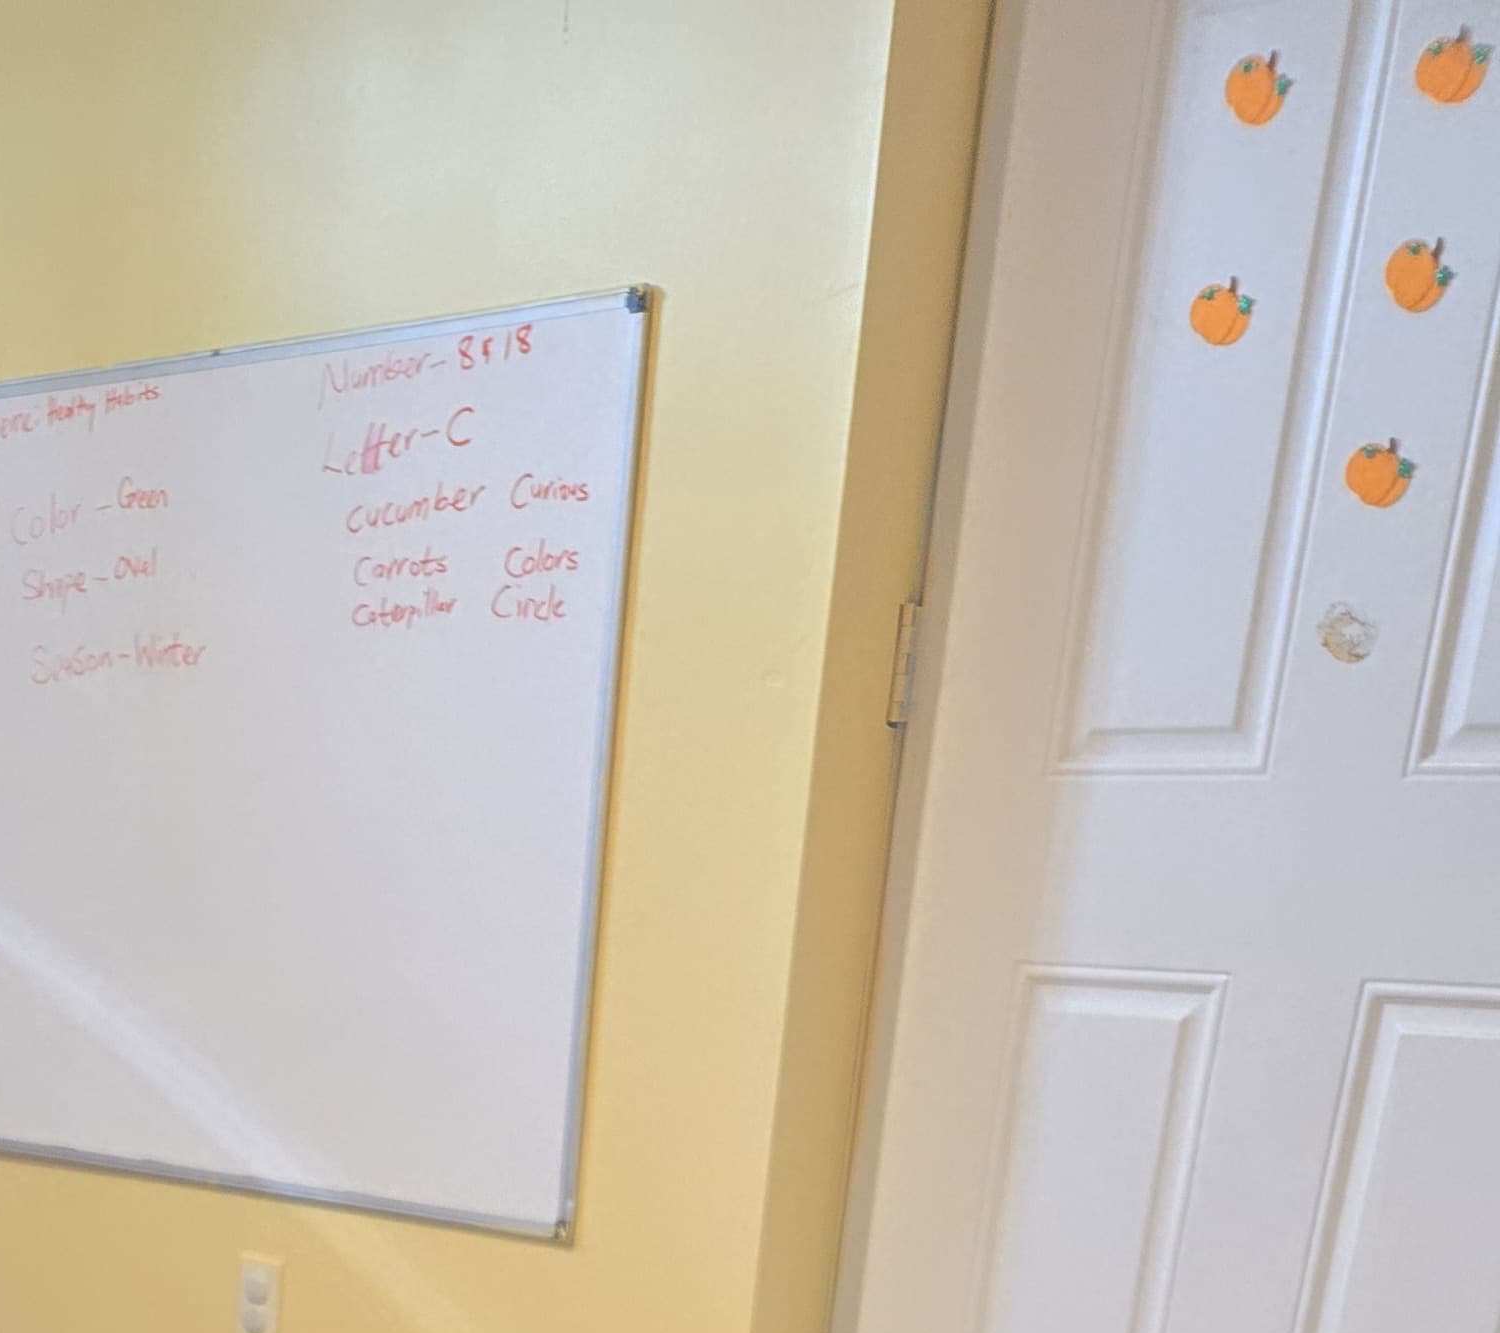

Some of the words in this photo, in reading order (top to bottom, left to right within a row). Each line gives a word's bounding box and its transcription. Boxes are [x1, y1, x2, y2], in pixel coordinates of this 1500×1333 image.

[457, 335, 476, 370] 8
[503, 323, 532, 361] 18
[447, 405, 475, 447] C
